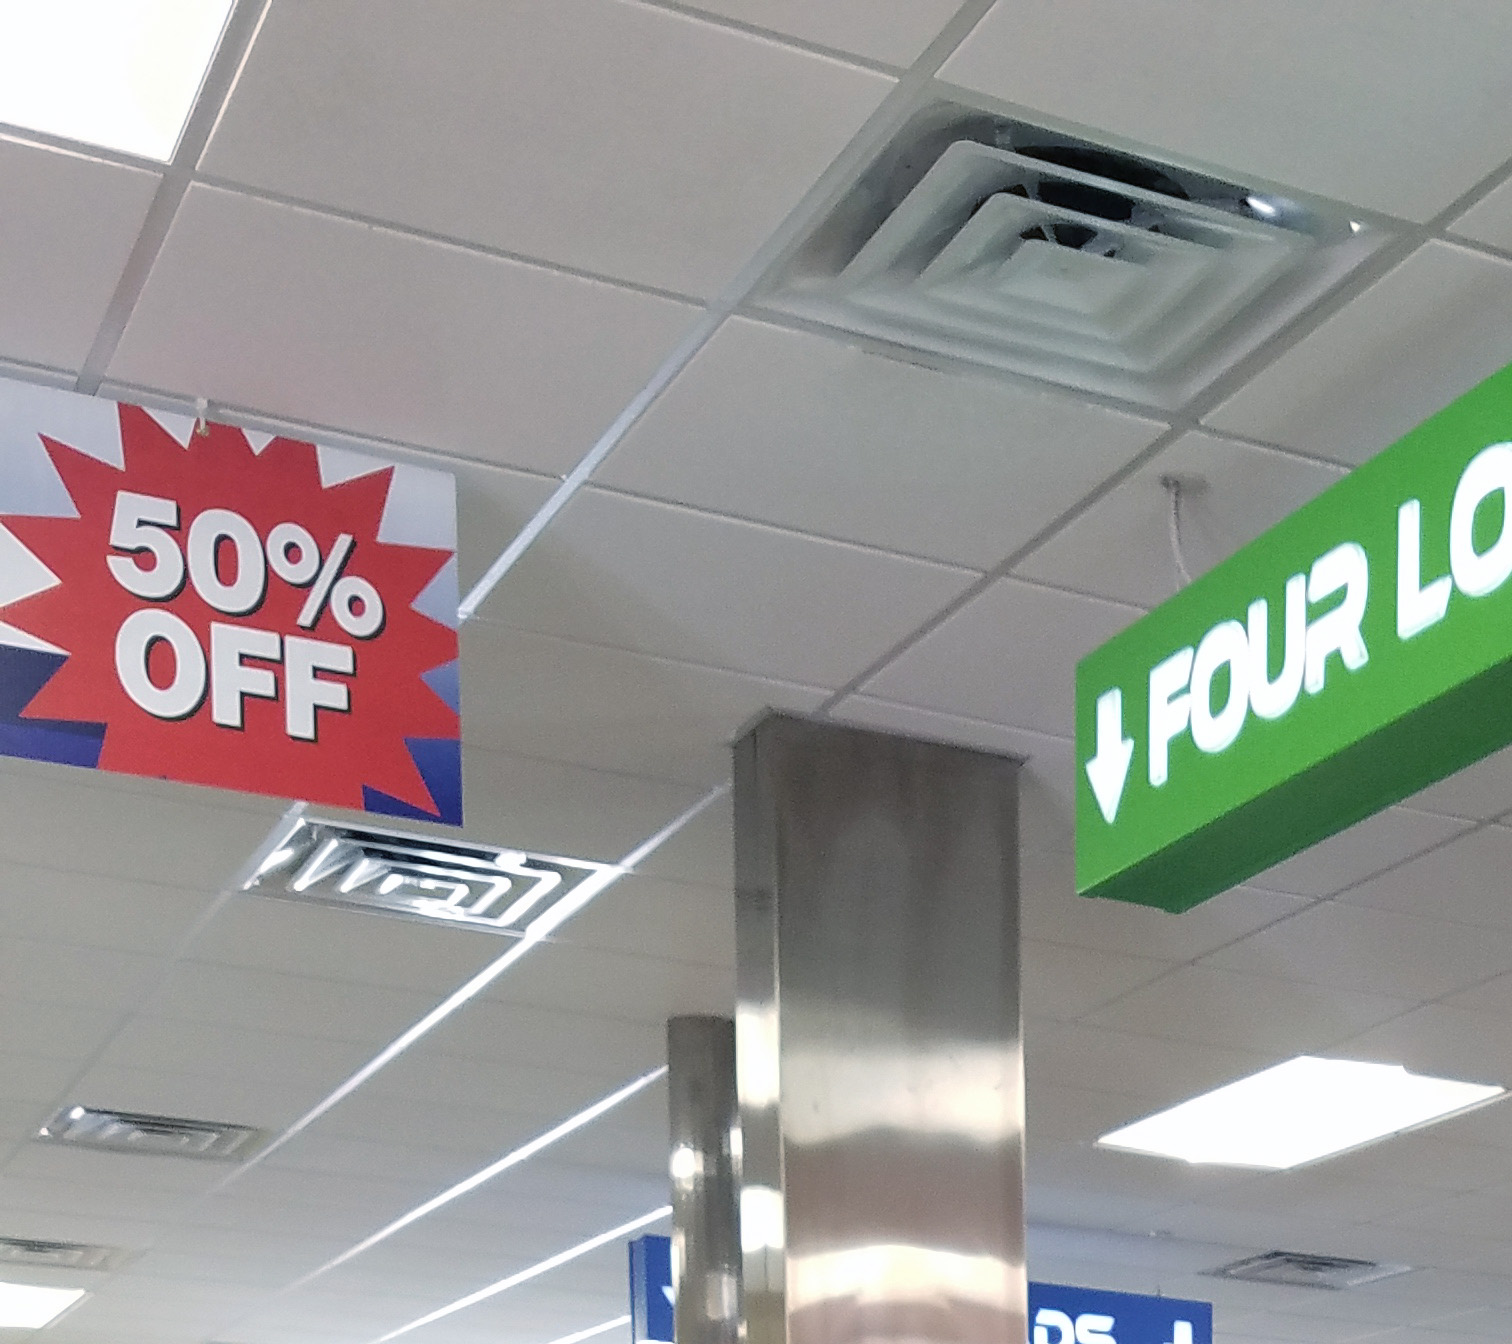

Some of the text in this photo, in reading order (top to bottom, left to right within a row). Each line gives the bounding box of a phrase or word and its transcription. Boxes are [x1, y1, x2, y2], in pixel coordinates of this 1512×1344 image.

[106, 490, 386, 639] 50%
[115, 608, 356, 742] OFF
[1148, 543, 1368, 786] FOUR
